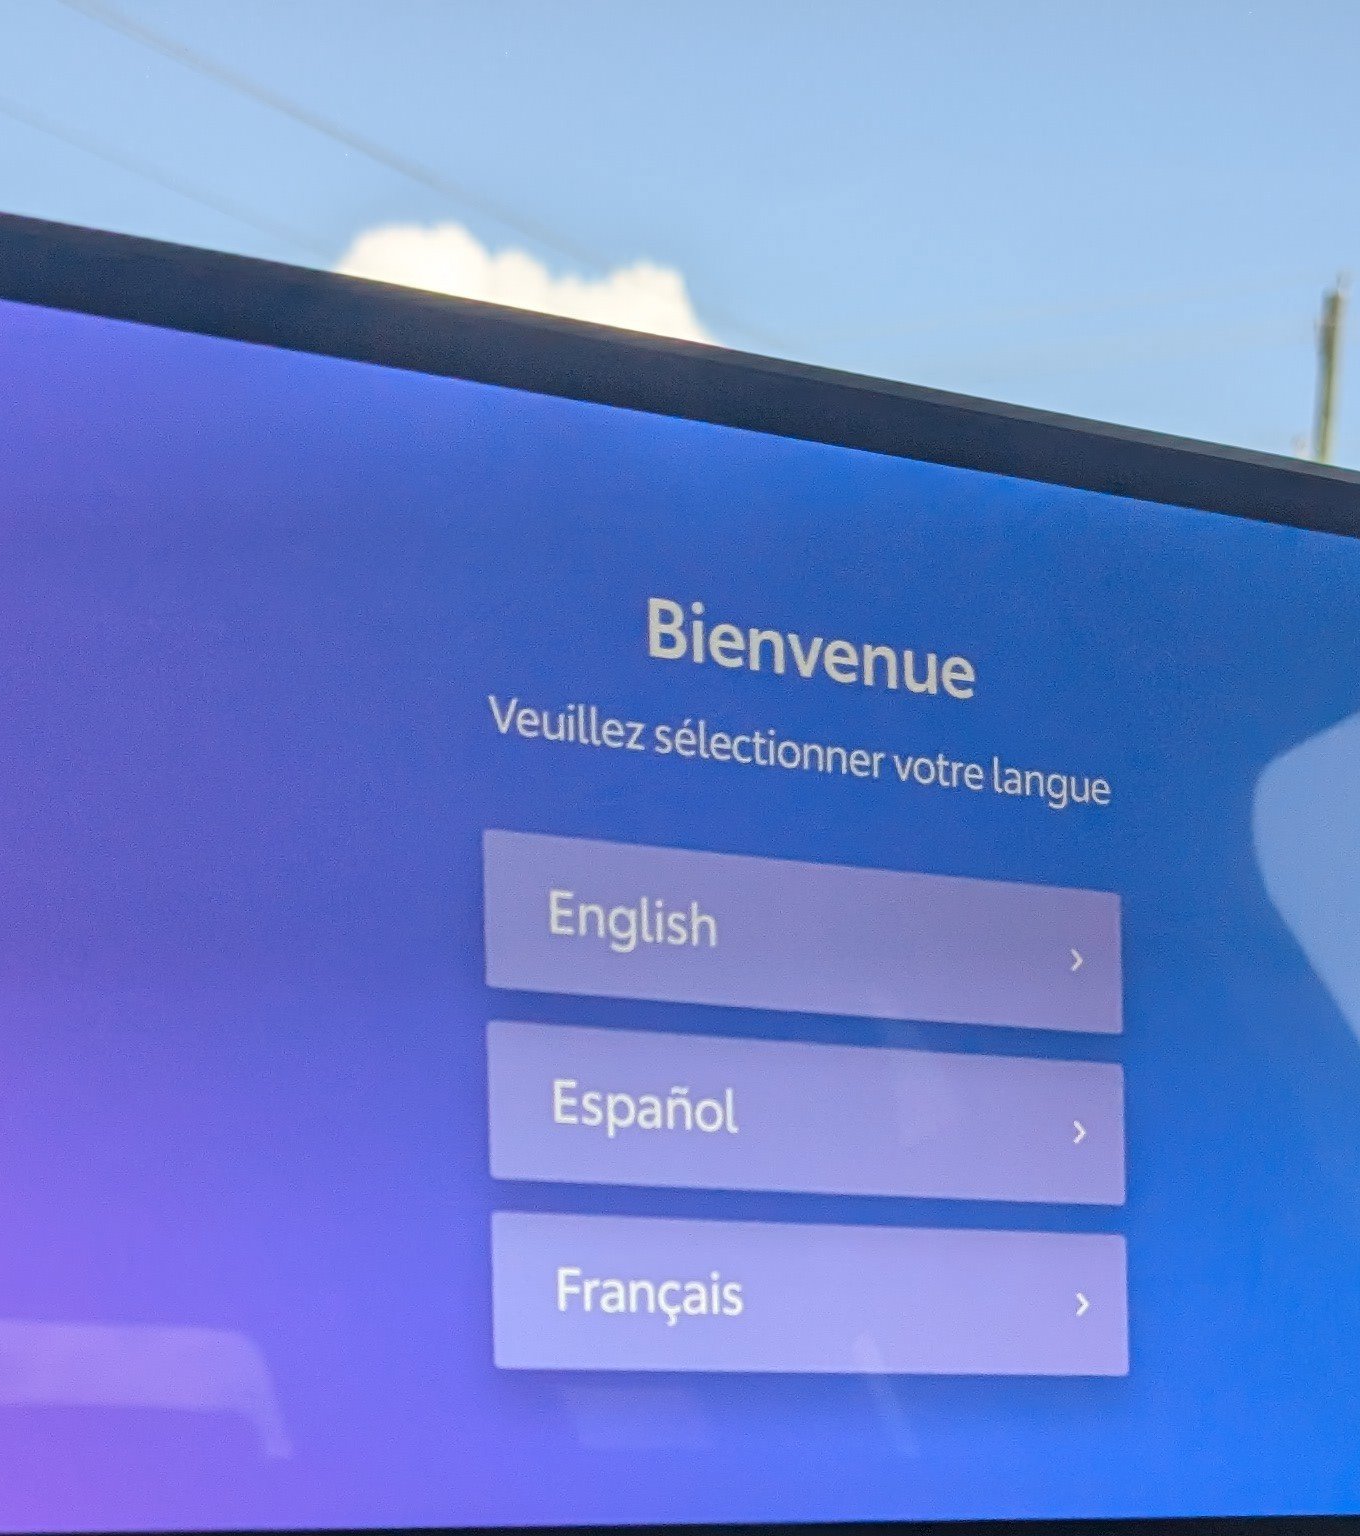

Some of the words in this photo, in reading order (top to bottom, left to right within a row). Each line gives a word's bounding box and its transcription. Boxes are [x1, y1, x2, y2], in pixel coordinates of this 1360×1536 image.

[647, 596, 977, 700] Bienvenue
[489, 695, 644, 752] Veuillez
[655, 718, 885, 779] sélectionner
[894, 753, 985, 791] votre
[993, 758, 1111, 809] langue
[548, 890, 719, 953] English
[553, 1079, 739, 1138] Español
[557, 1267, 744, 1326] Français
